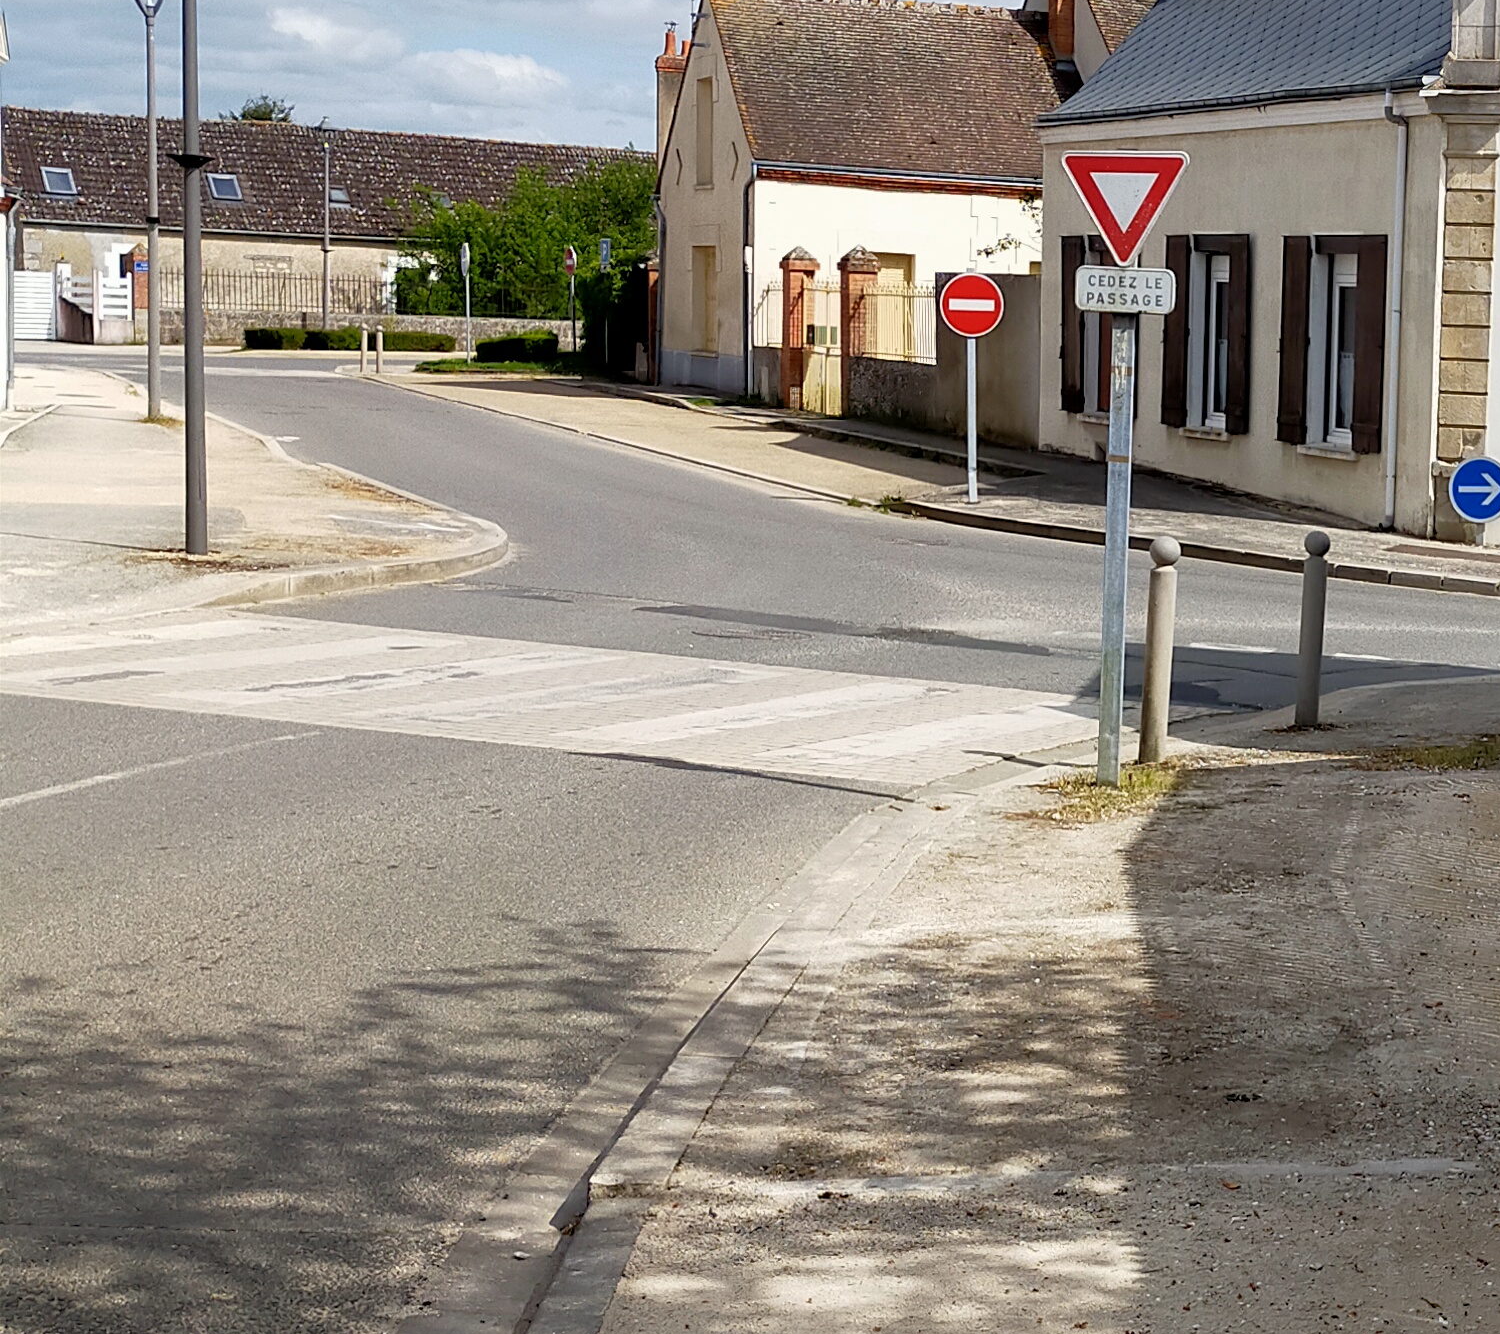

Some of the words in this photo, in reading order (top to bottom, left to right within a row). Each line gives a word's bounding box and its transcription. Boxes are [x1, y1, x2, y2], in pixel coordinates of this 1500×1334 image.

[1087, 274, 1137, 289] CEDEZ
[1145, 277, 1163, 290] LE
[1086, 292, 1163, 307] PASSAGE
